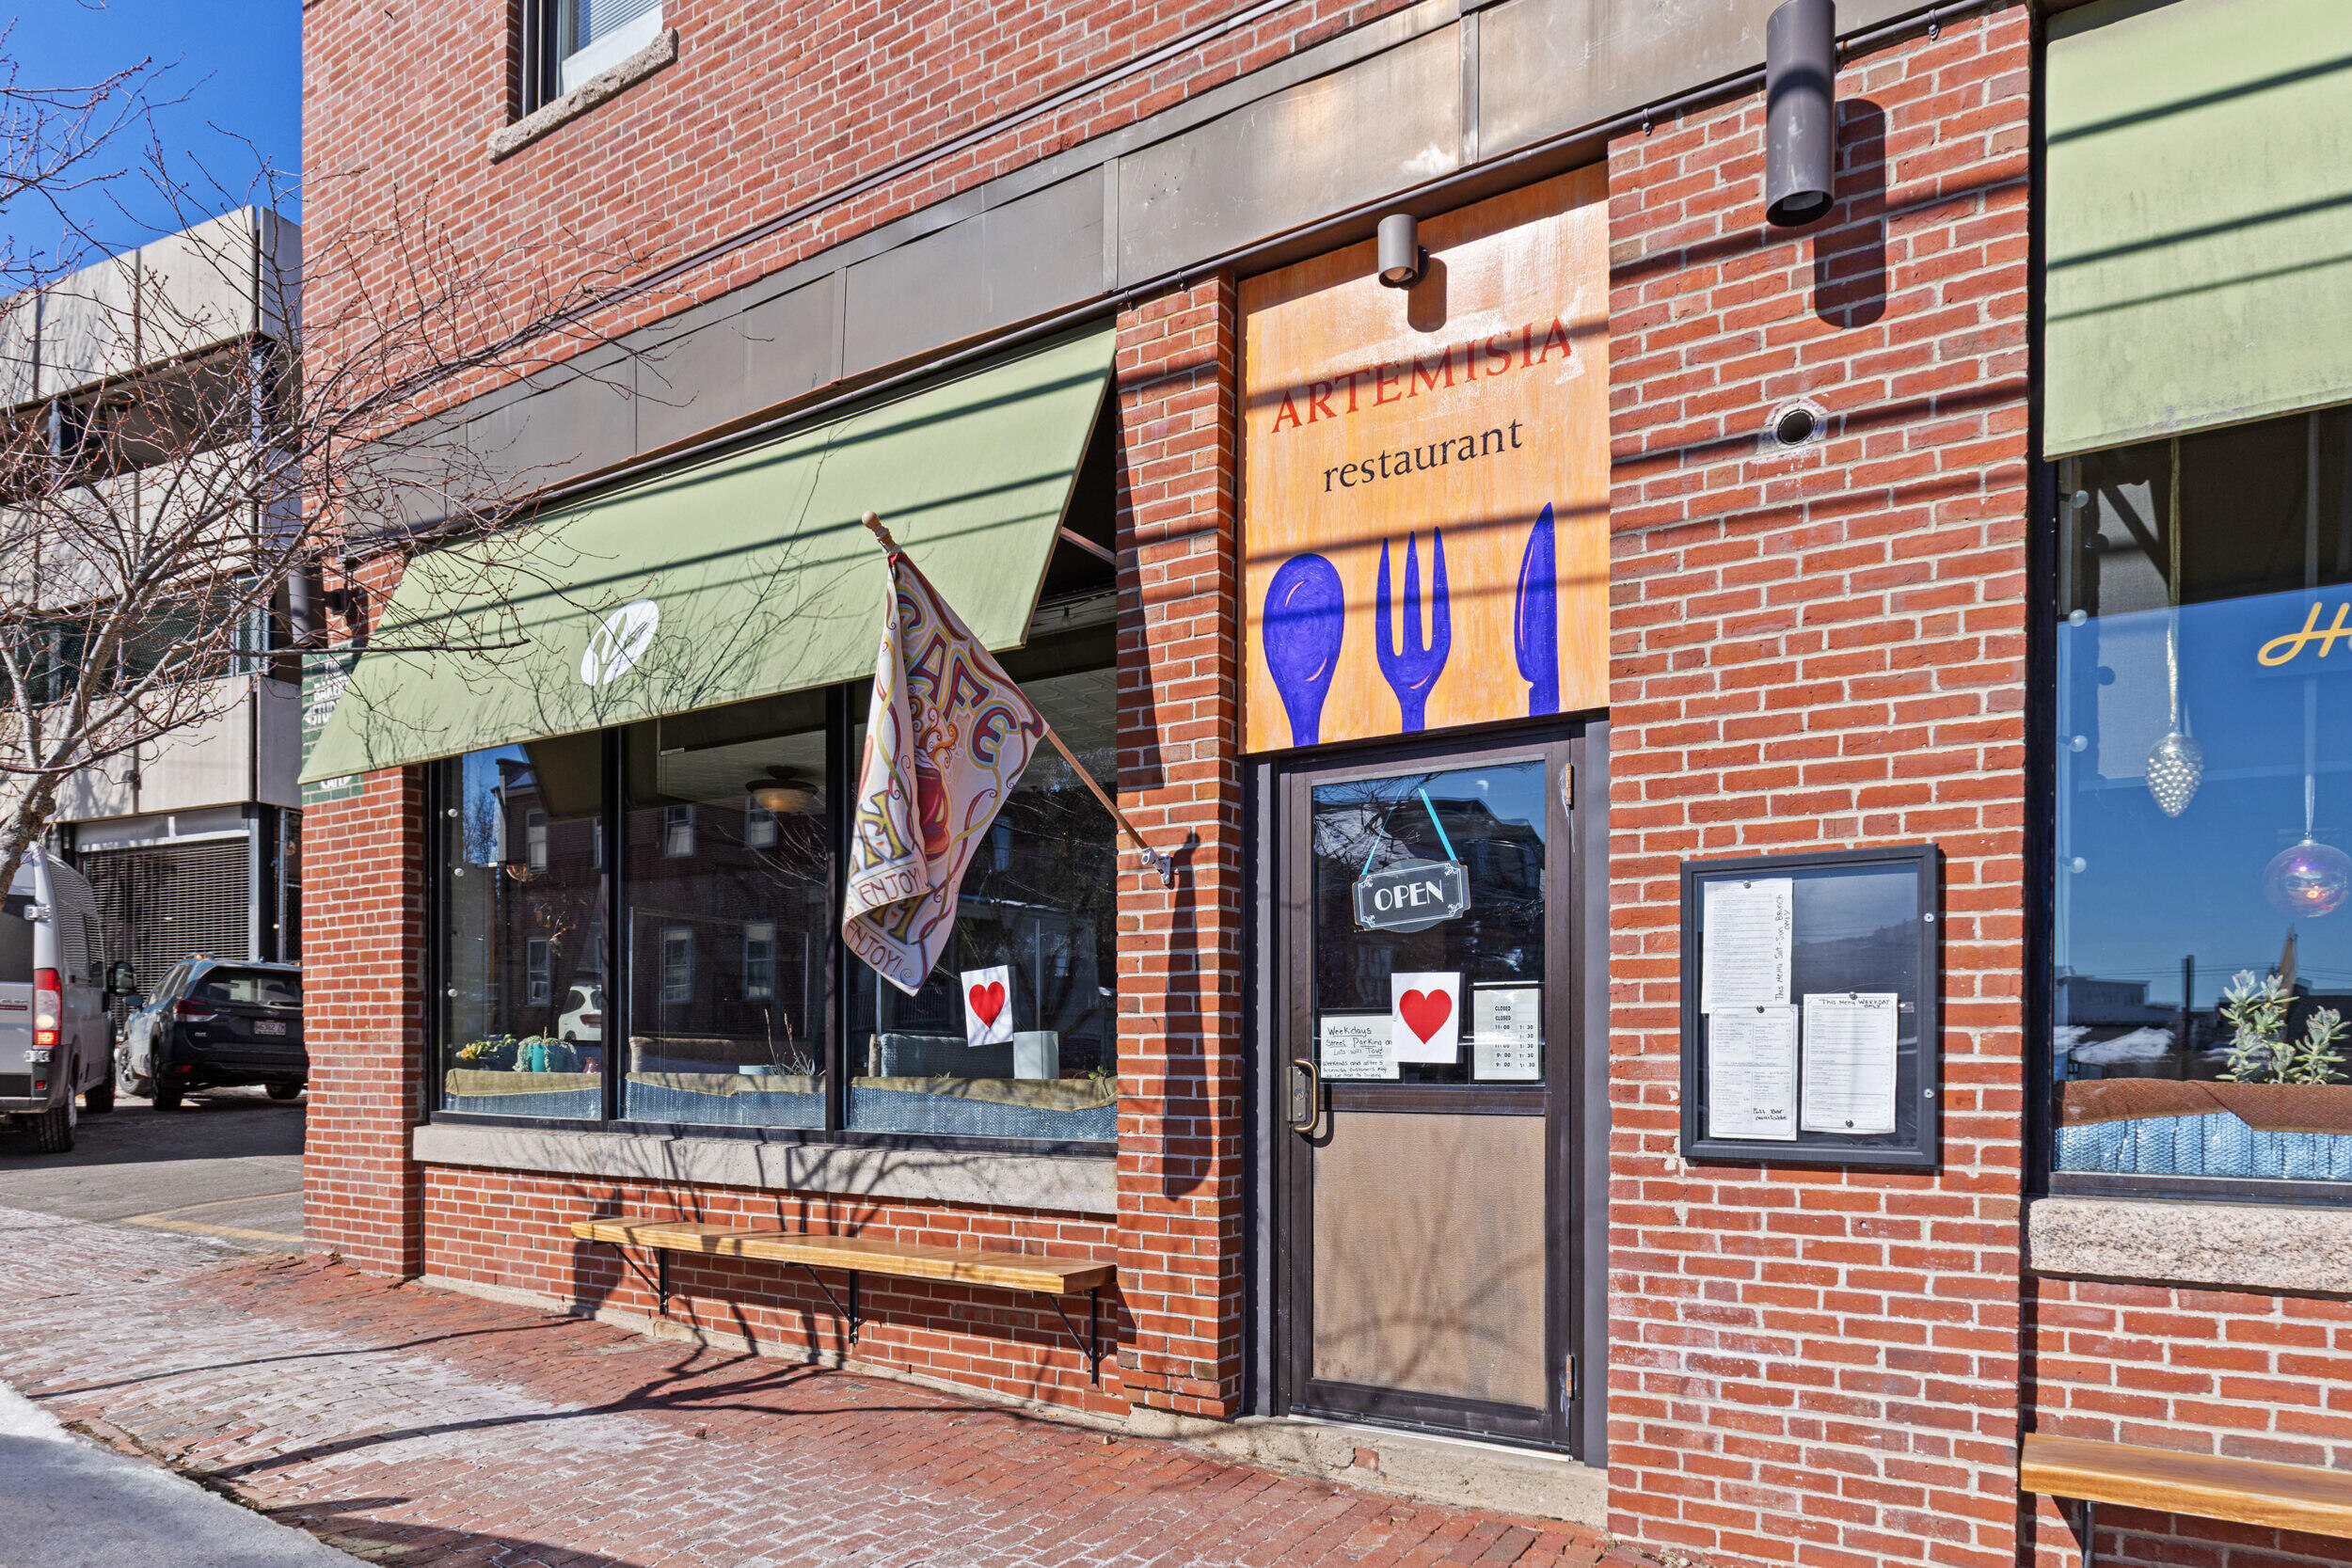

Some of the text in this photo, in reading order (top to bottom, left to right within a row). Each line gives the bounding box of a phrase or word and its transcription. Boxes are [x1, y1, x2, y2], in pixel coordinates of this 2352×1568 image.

[1271, 315, 1573, 434] ARTEMISIA
[1324, 420, 1523, 493] restaurant
[858, 866, 928, 907] ENJOY!
[1375, 879, 1444, 911] OPEN
[1327, 1025, 1373, 1038] Weekdays
